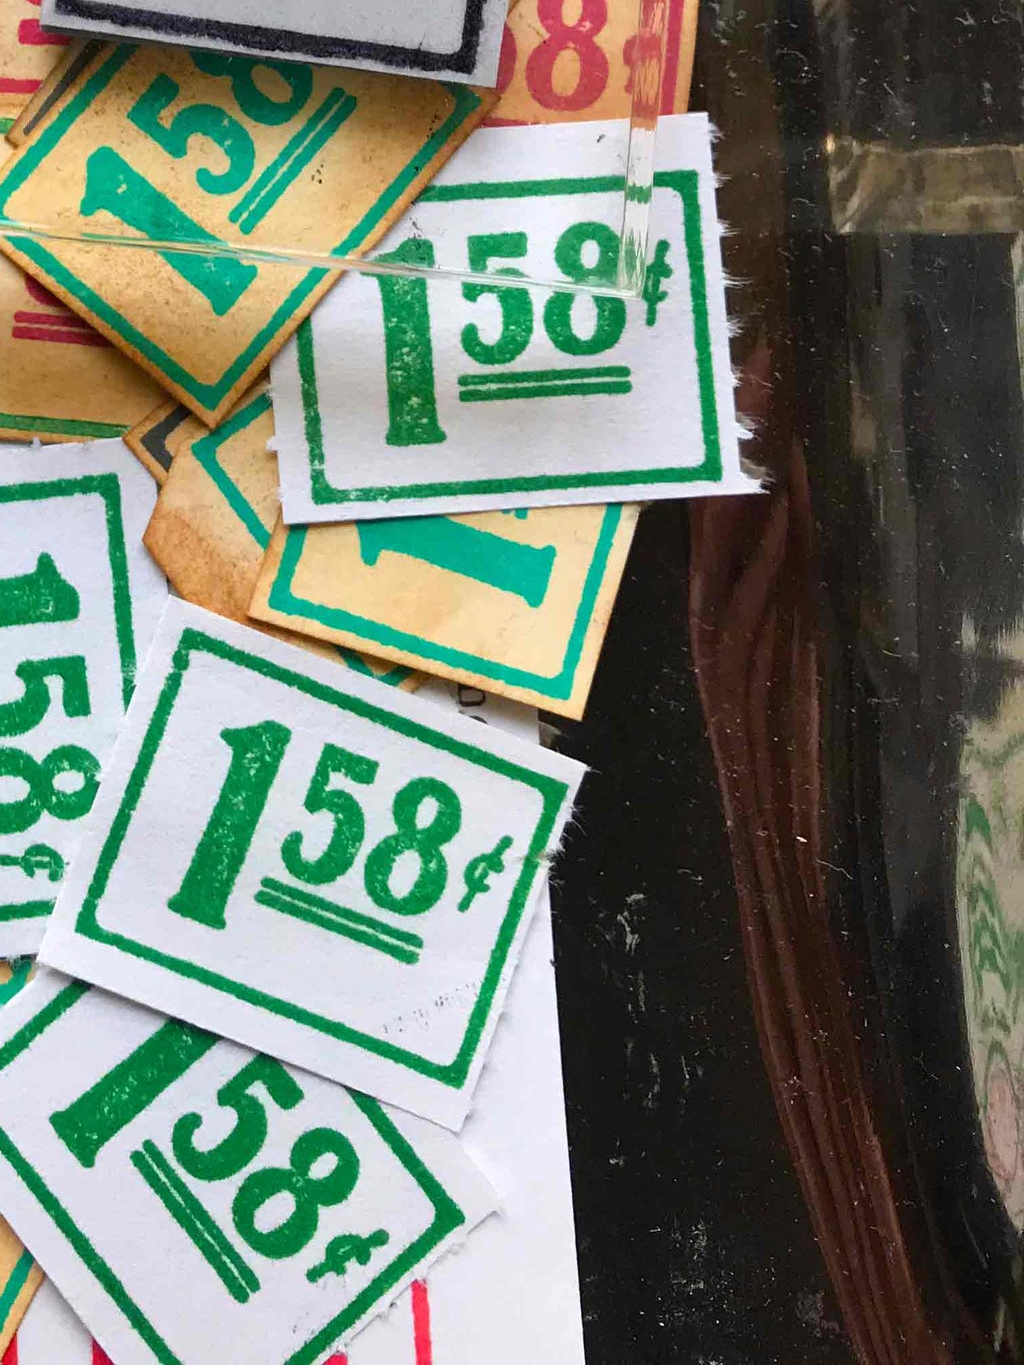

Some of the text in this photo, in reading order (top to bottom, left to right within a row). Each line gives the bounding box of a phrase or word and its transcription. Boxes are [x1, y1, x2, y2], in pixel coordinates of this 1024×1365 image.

[360, 221, 674, 448] 158¢
[167, 720, 514, 931] 158¢
[48, 1018, 390, 1285] 158¢
